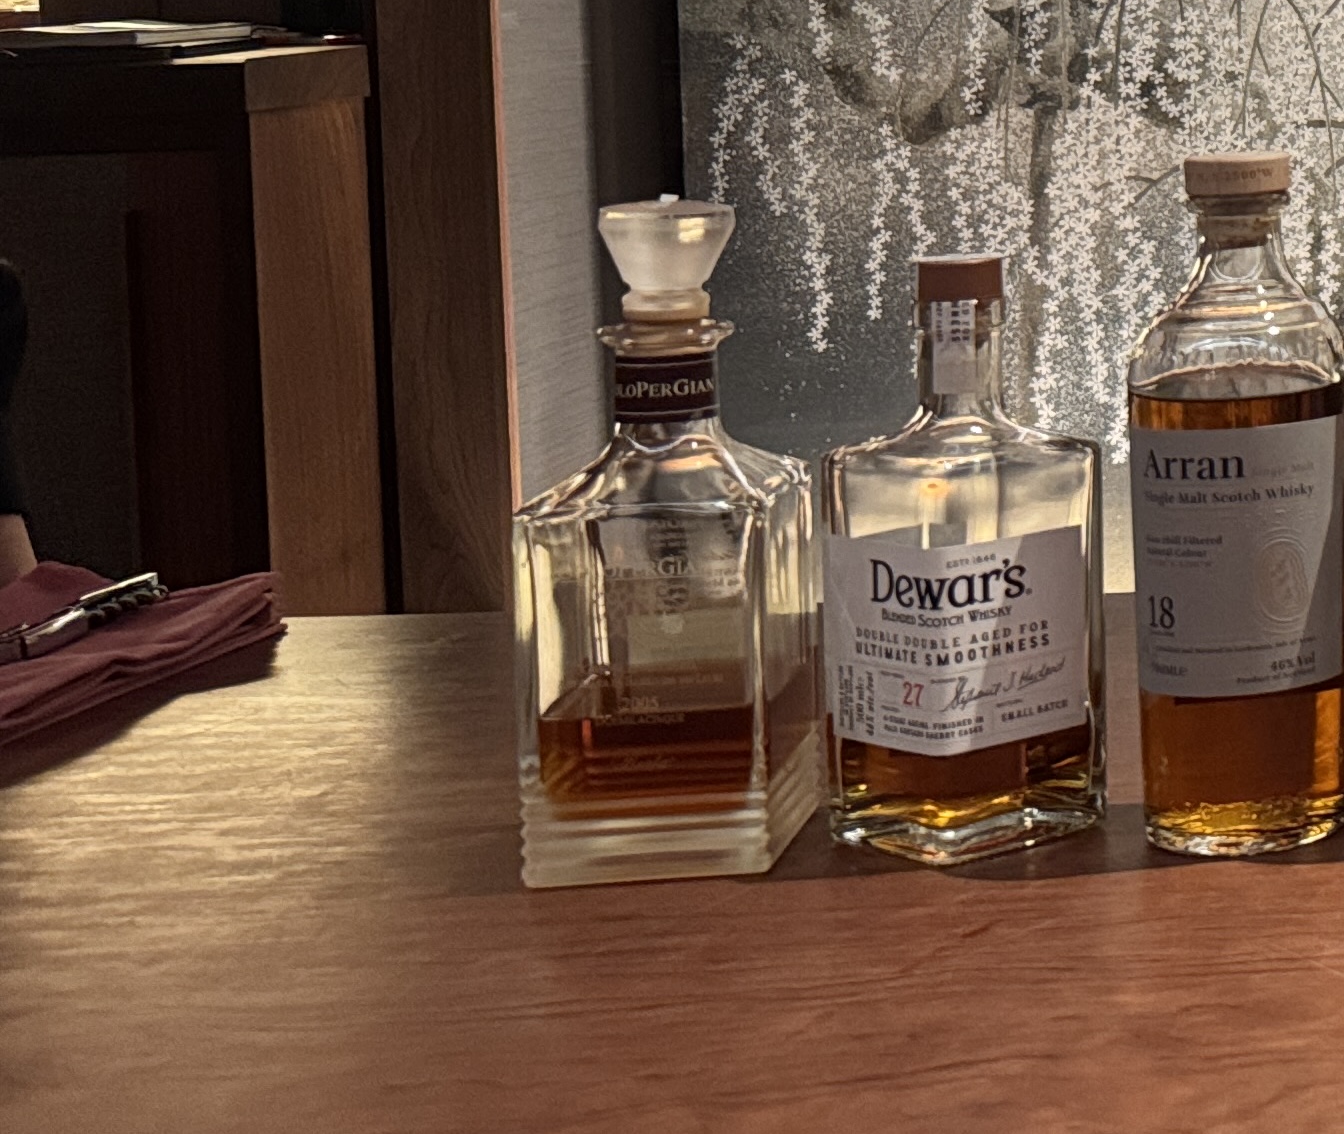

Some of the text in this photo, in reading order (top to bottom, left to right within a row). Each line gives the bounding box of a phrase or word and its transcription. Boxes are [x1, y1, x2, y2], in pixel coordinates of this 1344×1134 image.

[1143, 449, 1246, 481] Arran
[1177, 490, 1208, 505] Malt
[1212, 486, 1260, 504] Scotch
[1265, 482, 1315, 501] Whisky
[869, 558, 1027, 611] Dewar's
[881, 605, 1013, 628] BLENDED SCOTCH WHISKY
[1148, 595, 1176, 630] 18
[855, 620, 1049, 650] DOUBLE DOUBLE AGED FOR
[856, 632, 1051, 667] ULTIMATE SMOOTHNESS
[902, 680, 926, 708] 27
[1036, 698, 1069, 715] BATCH
